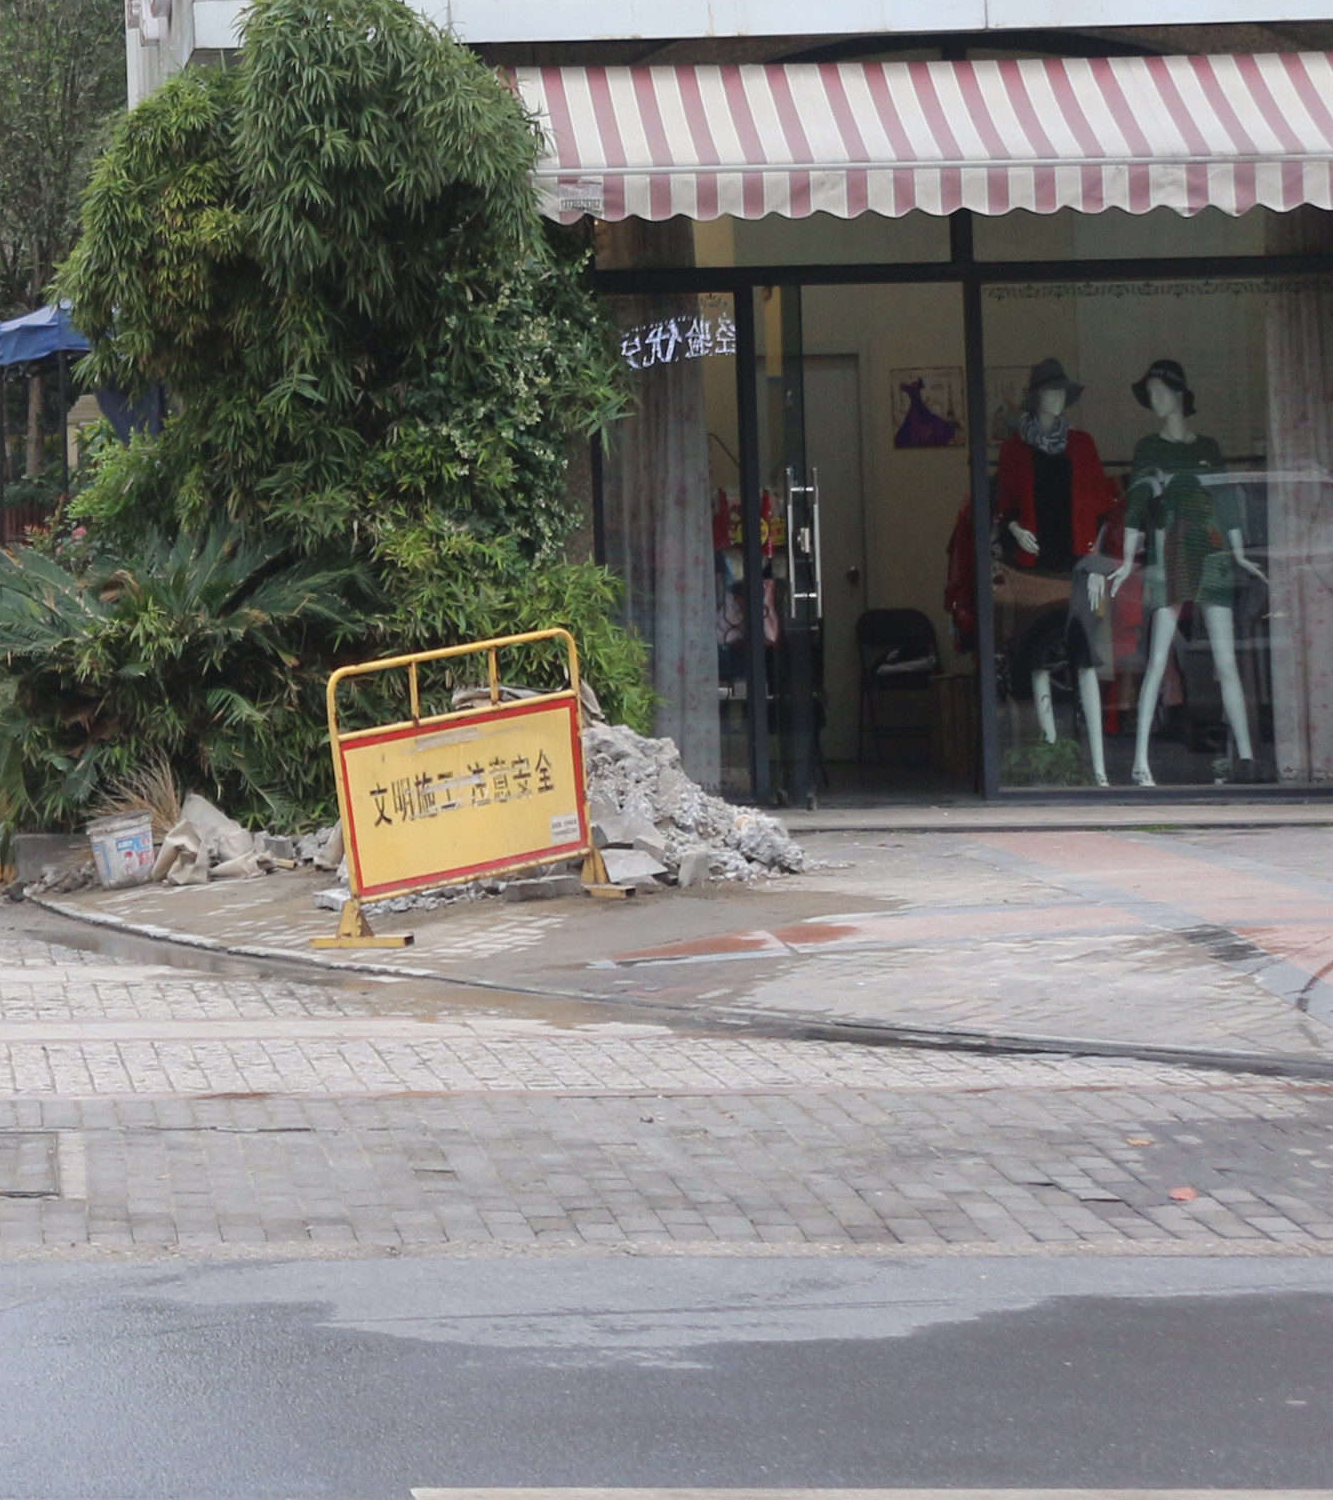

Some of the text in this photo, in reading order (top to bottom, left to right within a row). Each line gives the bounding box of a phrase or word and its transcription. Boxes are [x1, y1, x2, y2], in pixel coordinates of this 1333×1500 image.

[369, 749, 554, 828] 文明施工注意安全
